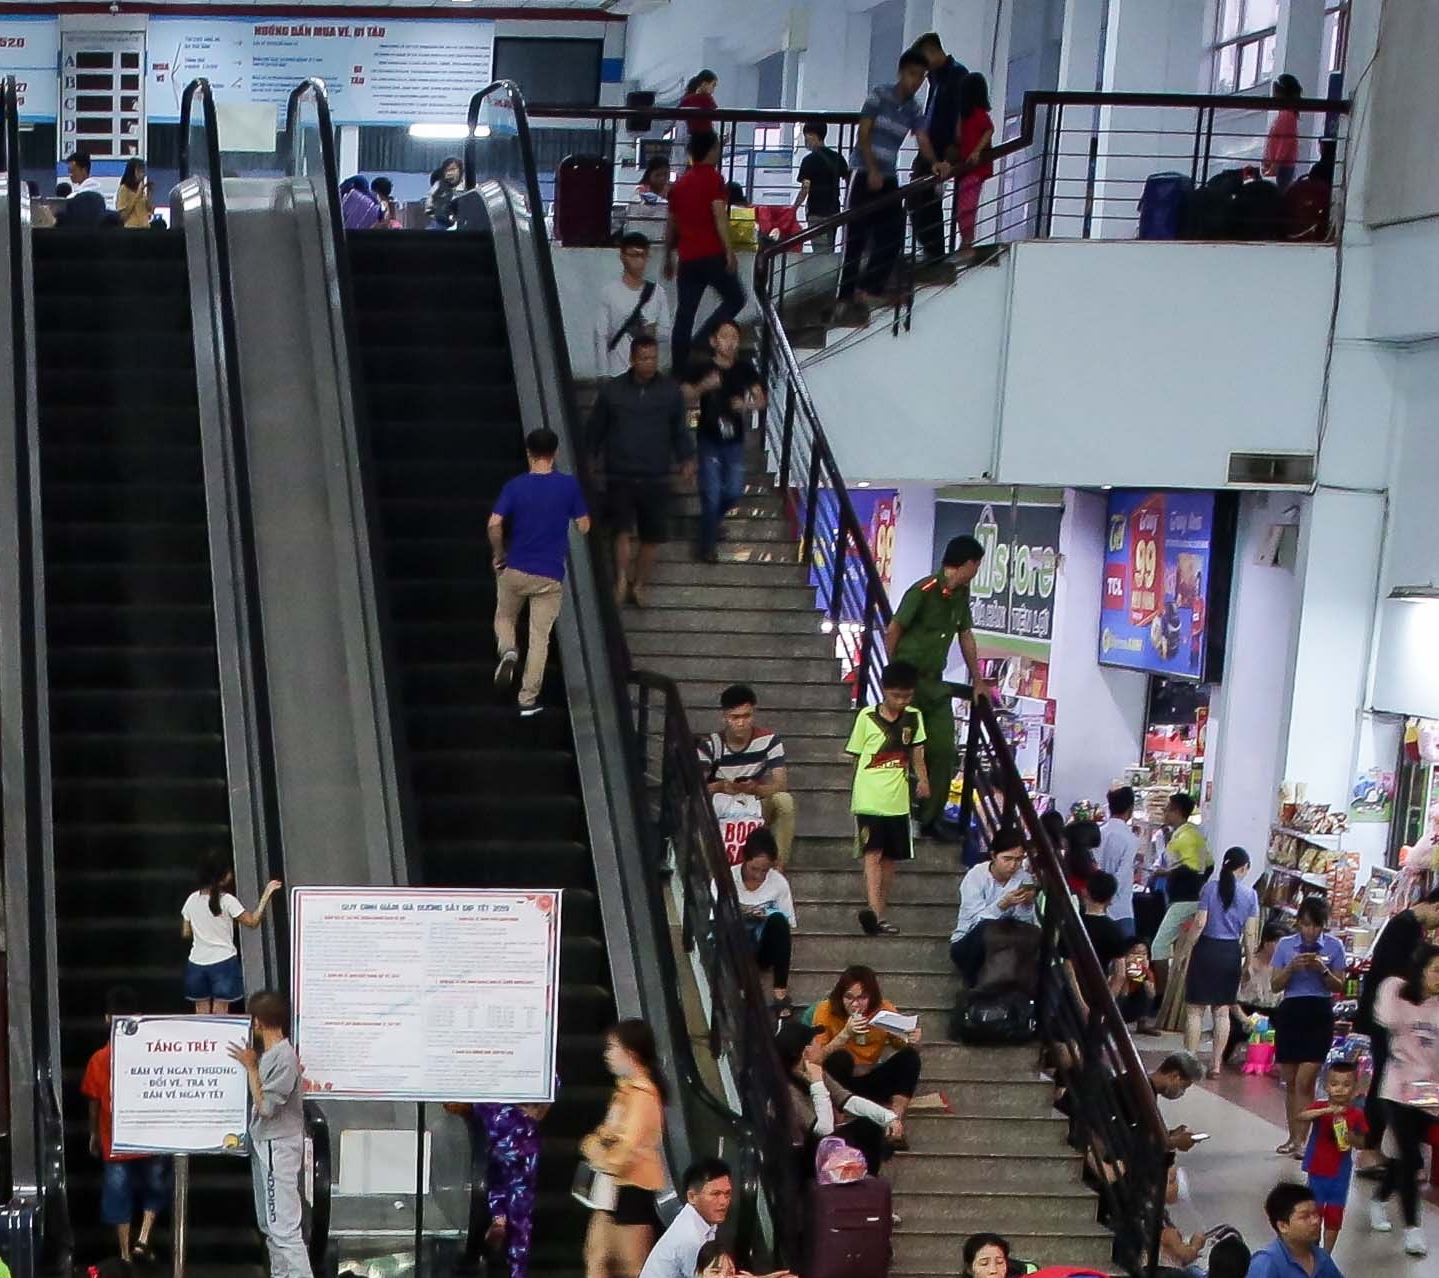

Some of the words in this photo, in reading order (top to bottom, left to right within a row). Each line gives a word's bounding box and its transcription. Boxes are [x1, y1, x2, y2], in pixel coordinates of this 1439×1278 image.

[64, 55, 75, 68] A
[64, 97, 75, 111] C
[971, 520, 1056, 600] Msore
[1135, 540, 1157, 589] 99
[1107, 576, 1124, 597] TCL
